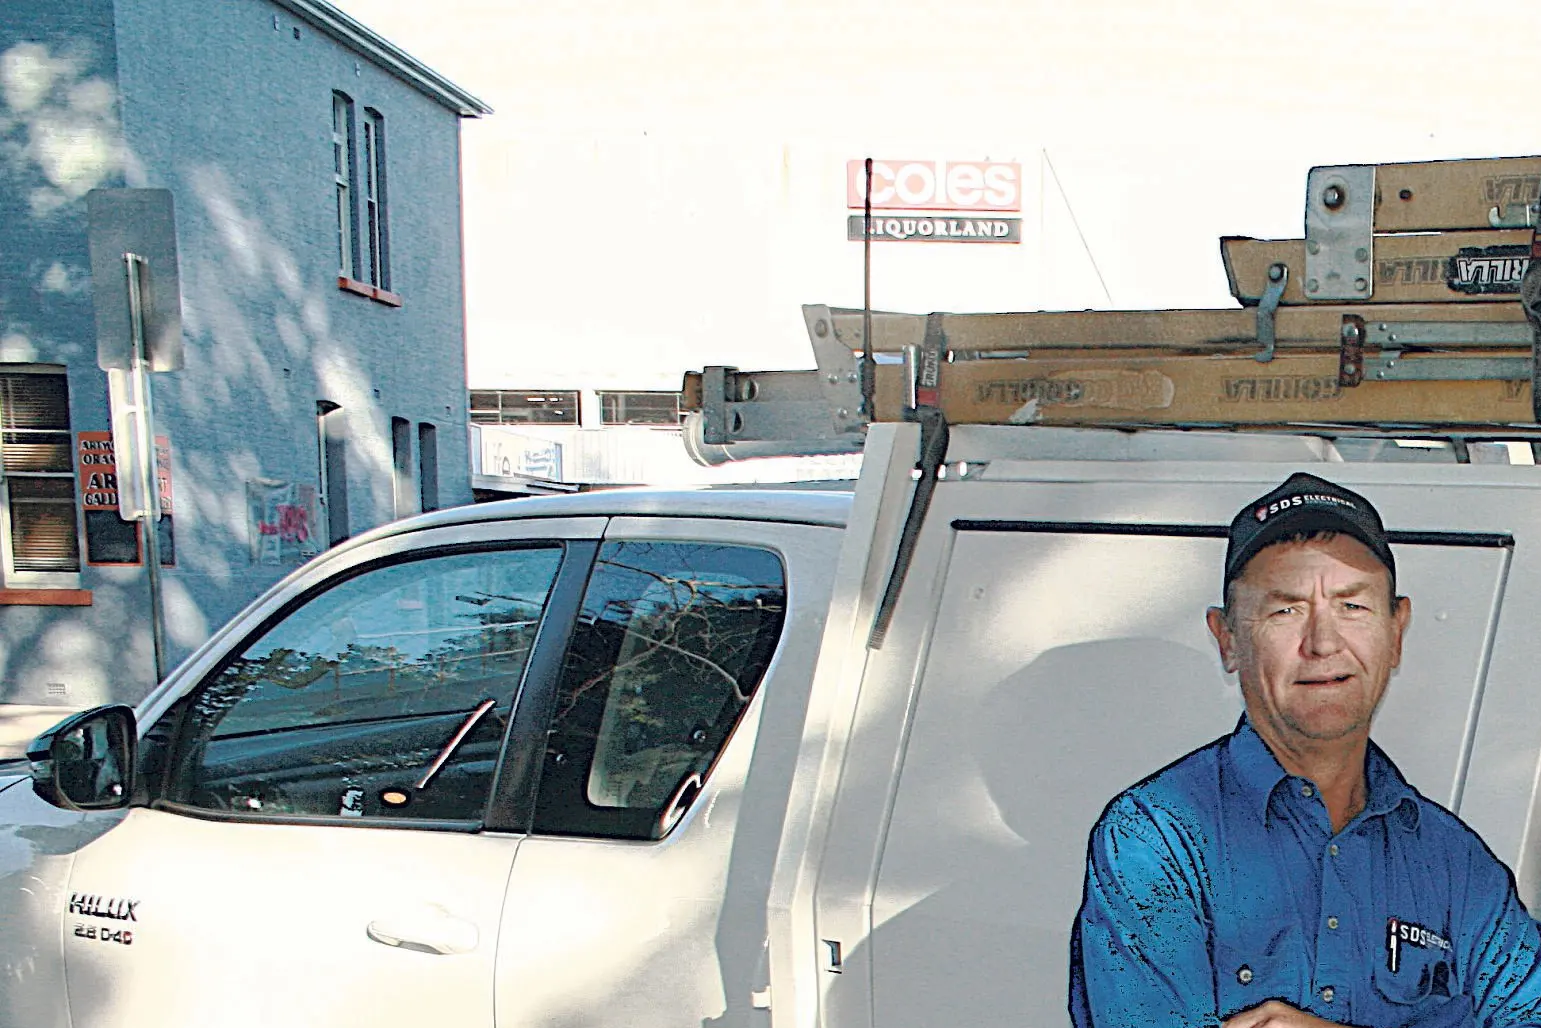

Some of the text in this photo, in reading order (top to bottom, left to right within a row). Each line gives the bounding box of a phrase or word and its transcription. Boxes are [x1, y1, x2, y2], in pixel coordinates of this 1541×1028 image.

[856, 161, 1017, 206] coles
[1377, 255, 1450, 287] ILLA
[1269, 495, 1303, 515] SDS
[68, 891, 141, 922] HILUX
[1400, 924, 1427, 946] SDS
